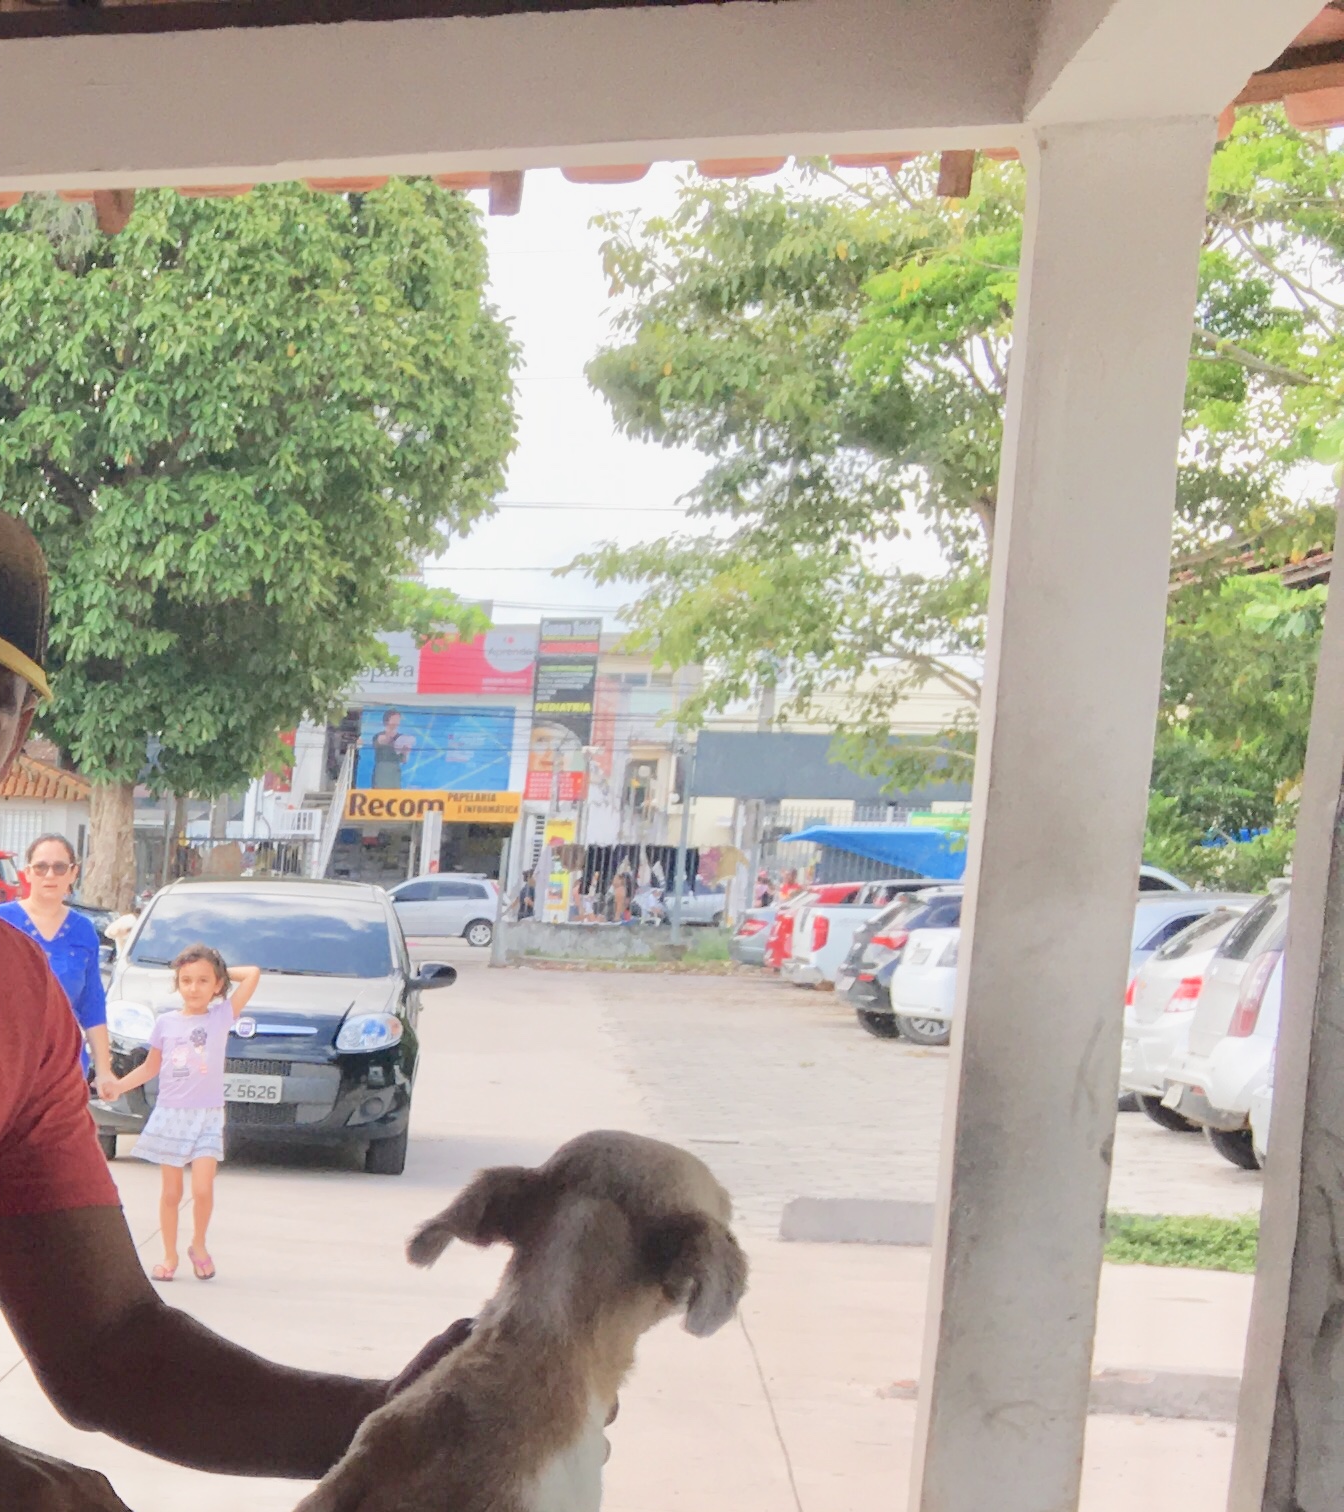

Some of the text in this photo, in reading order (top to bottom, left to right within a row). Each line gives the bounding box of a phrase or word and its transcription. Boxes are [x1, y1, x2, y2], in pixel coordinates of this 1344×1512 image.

[360, 663, 415, 683] epara
[535, 702, 592, 712] PEDIATRIA
[349, 792, 497, 817] Recom PAPELARIA
[463, 804, 519, 815] INFORMÁTICA
